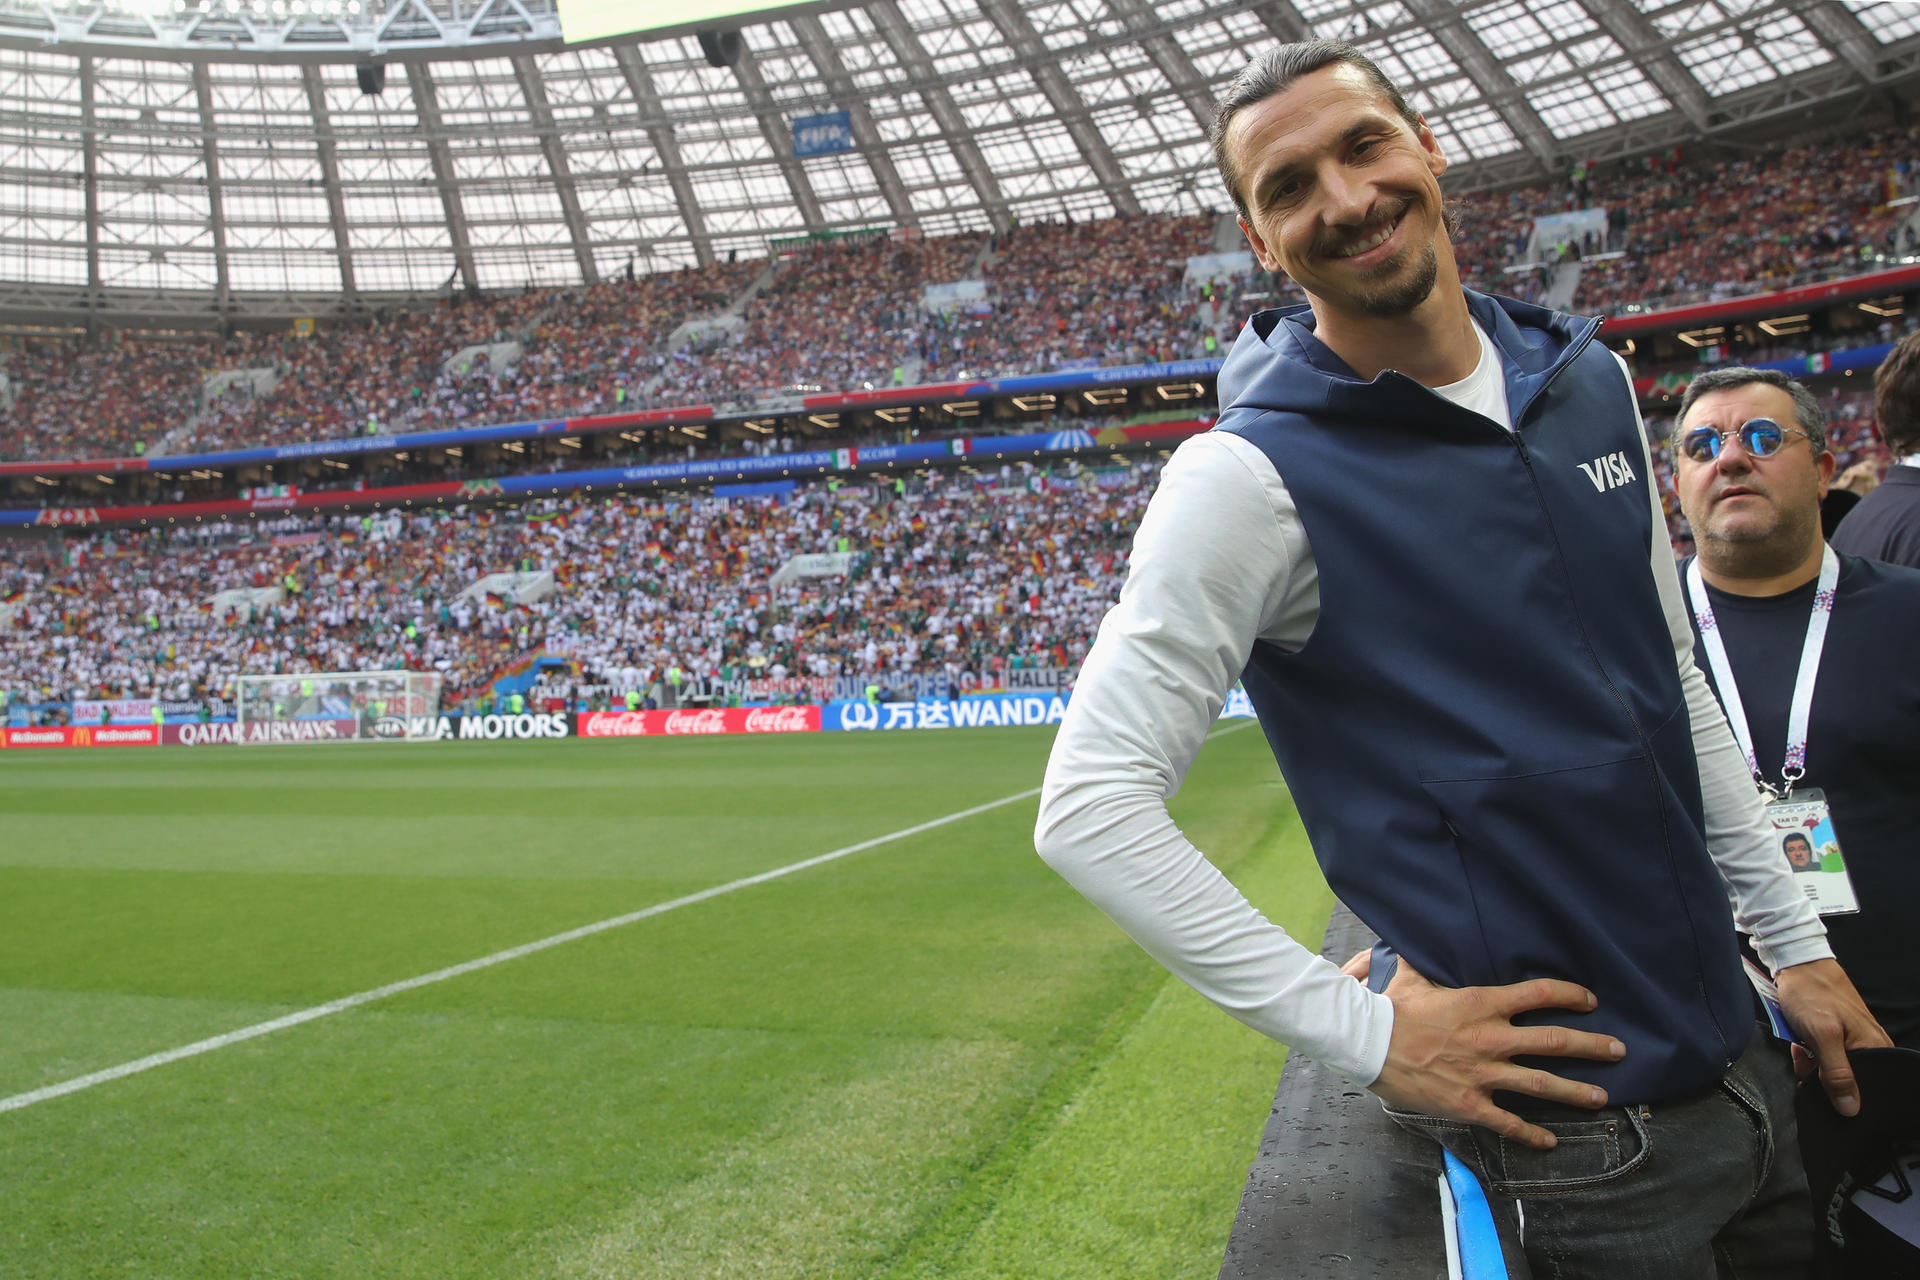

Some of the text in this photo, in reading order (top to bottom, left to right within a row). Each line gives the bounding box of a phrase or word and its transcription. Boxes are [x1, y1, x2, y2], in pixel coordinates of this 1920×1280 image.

[1576, 451, 1636, 492] VISA
[459, 713, 569, 739] MOTORS
[586, 711, 646, 737] Coca-Cola
[664, 709, 727, 735] Coca-Cola
[745, 707, 809, 733] Coca-Cola
[882, 697, 1066, 730] 万达 WANDA
[178, 720, 337, 746] QATAR AIRWAYS
